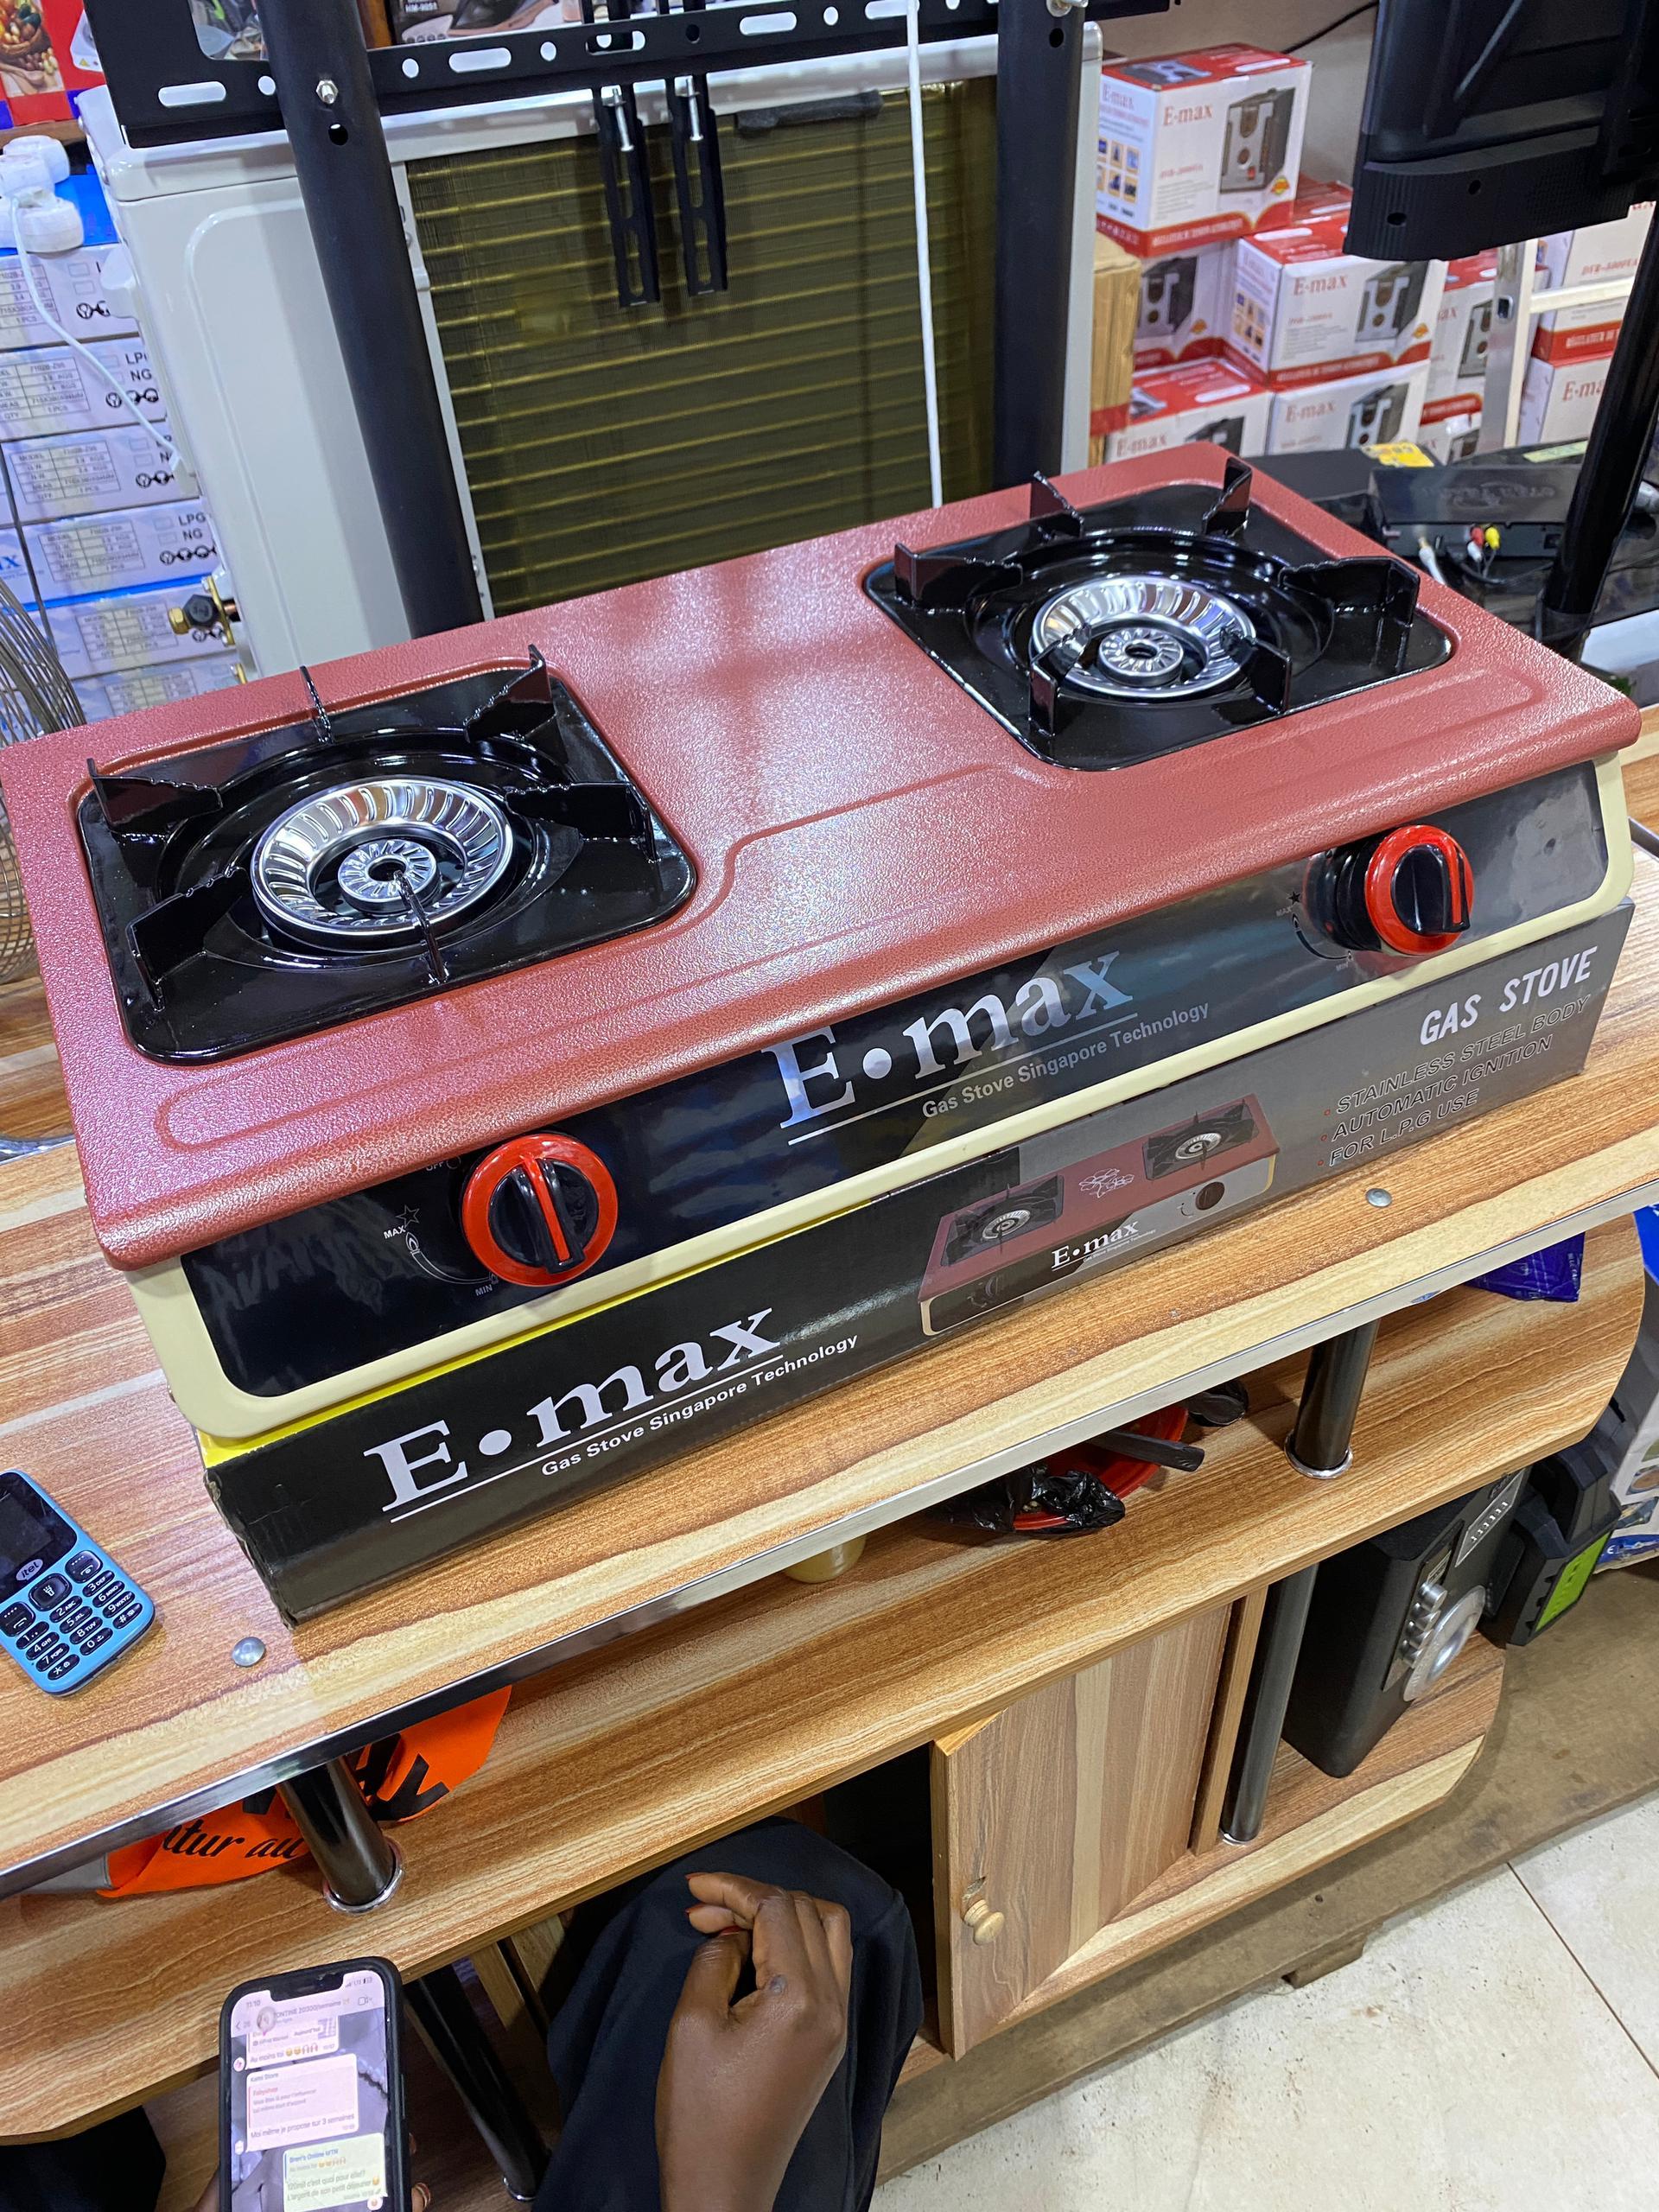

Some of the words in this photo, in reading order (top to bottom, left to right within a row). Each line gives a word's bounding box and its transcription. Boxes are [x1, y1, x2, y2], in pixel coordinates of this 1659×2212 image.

[125, 352, 148, 365] LP
[130, 369, 152, 381] NG
[160, 451, 172, 463] N
[179, 512, 206, 525] LPG
[183, 528, 202, 541] NG
[1420, 995, 1482, 1045] GAS
[1499, 946, 1597, 1013] STOVE
[922, 1096, 958, 1120] Gas
[962, 1073, 1014, 1105] Stove
[1018, 1039, 1108, 1084] Singapore
[1110, 1002, 1209, 1050] Technology
[1336, 1052, 1455, 1115] STAINLESS
[1460, 1024, 1526, 1062] STEEL
[1530, 995, 1591, 1033] BODY
[1332, 1076, 1458, 1141] AUTOMATIC
[1463, 1034, 1554, 1085] IGNITION
[1329, 1134, 1374, 1167] FOR
[1379, 1110, 1431, 1145] L.P.G
[1437, 1089, 1479, 1120] USE
[384, 1224, 406, 1239] MAX
[475, 1284, 493, 1296] MIN
[542, 1452, 582, 1476] Gas
[586, 1424, 645, 1458] Stove
[649, 1383, 747, 1431] Singapore
[751, 1333, 859, 1385] Technology
[21, 1561, 39, 1578] itel
[87, 1583, 97, 1592] 3
[99, 1593, 106, 1602] 6
[108, 1604, 116, 1612] 9
[67, 1618, 74, 1626] 5
[77, 1629, 85, 1637] 8
[34, 1644, 41, 1653] 4
[86, 1640, 95, 1649] 0
[42, 1656, 50, 1664] 7
